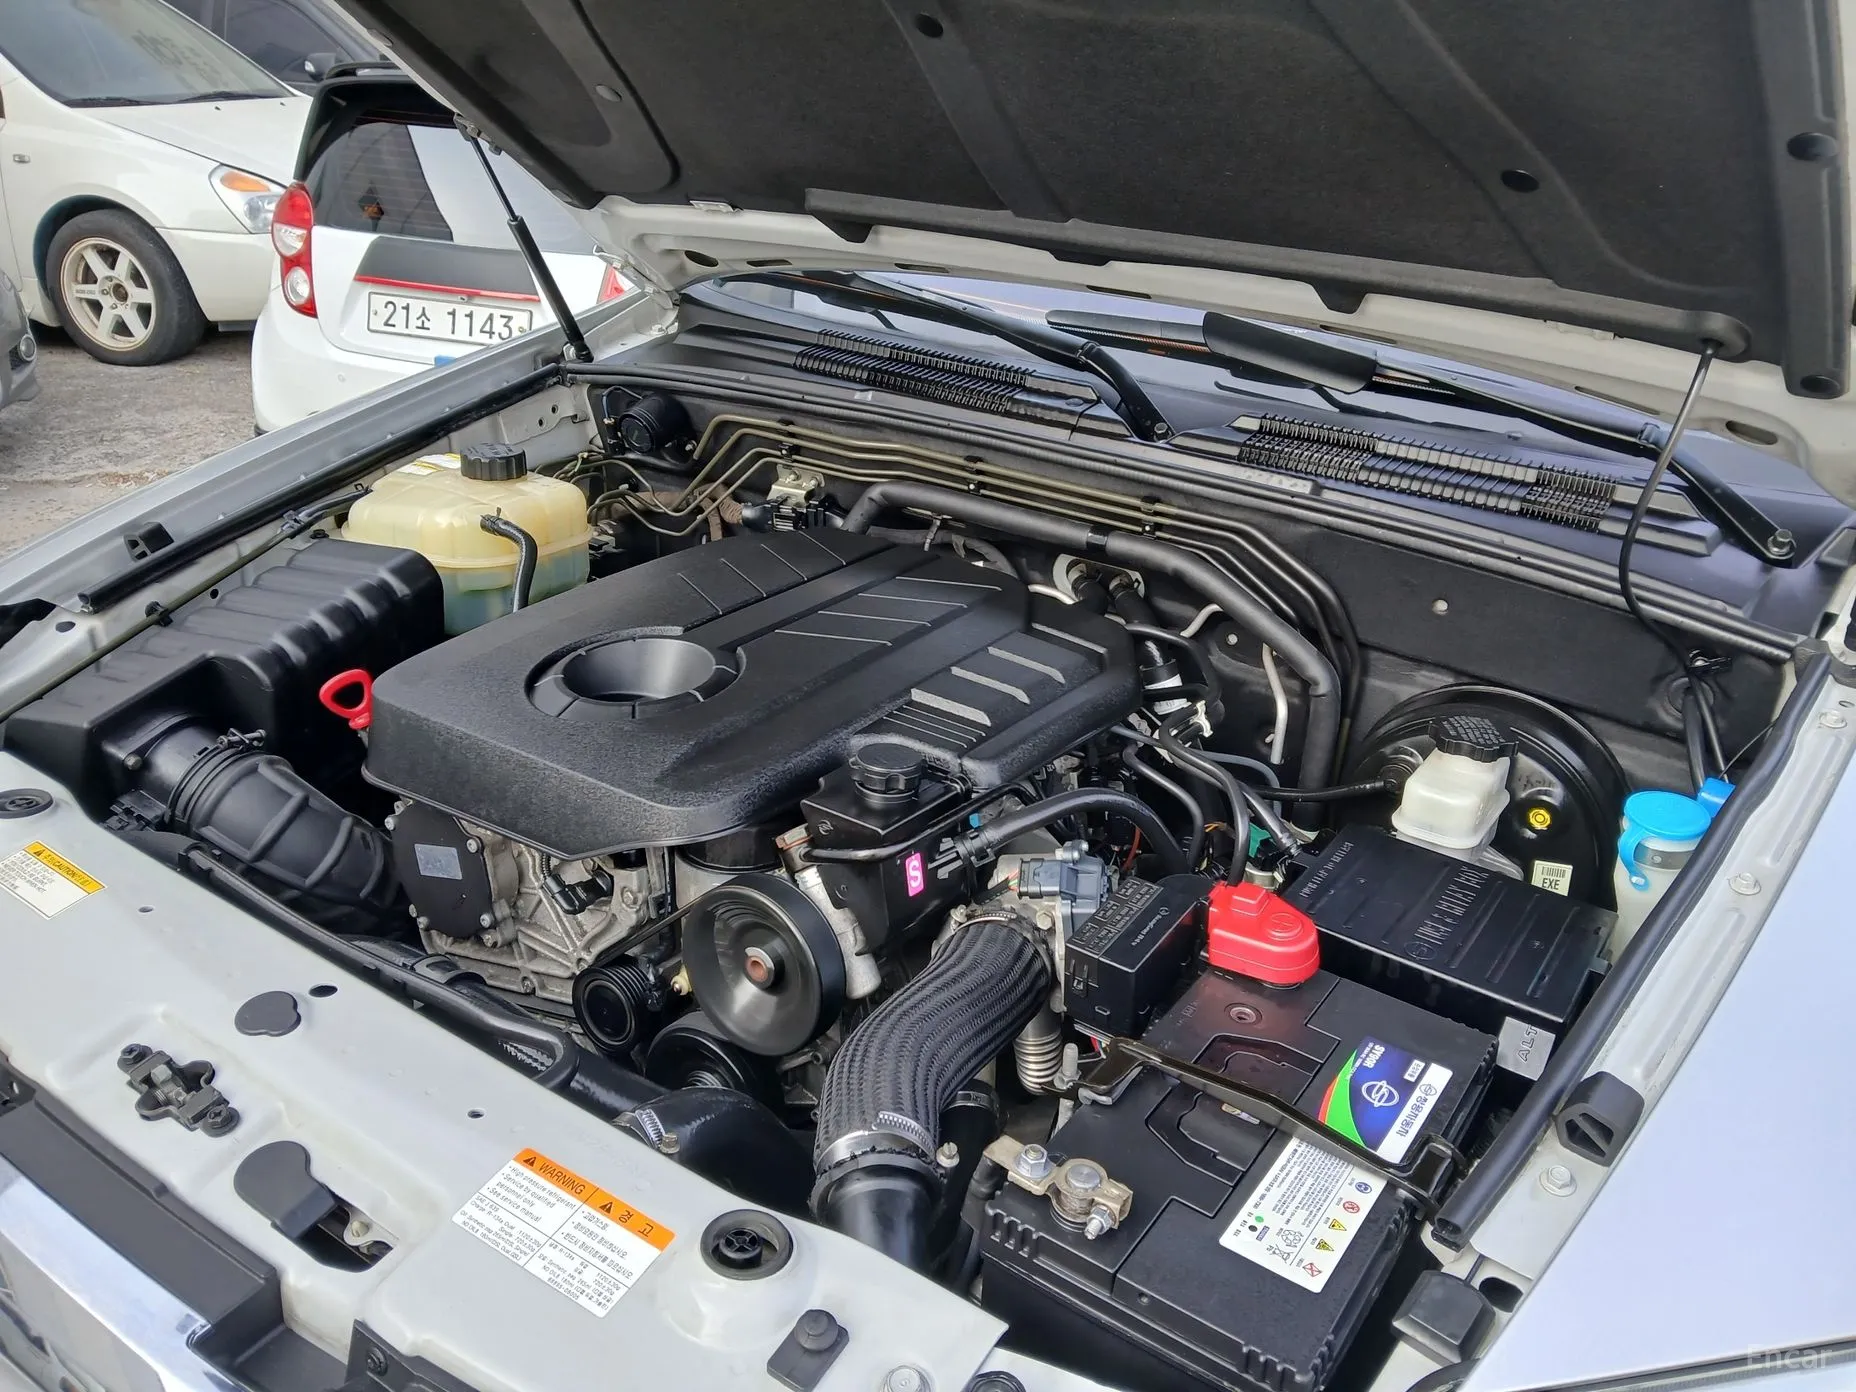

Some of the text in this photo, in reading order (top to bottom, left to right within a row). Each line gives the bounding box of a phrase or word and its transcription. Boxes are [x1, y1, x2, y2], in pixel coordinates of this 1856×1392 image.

[383, 301, 514, 341] 21소 1143
[908, 859, 921, 888] S
[1541, 877, 1561, 890] EXE
[1517, 1024, 1538, 1062] ALT
[1396, 1095, 1428, 1137] 쌍용자동차
[496, 1181, 535, 1208] personnel only
[503, 1173, 556, 1209] Service by qualified
[510, 1167, 577, 1210] High pressure refrigerant
[539, 1162, 586, 1195] WARNING
[489, 1187, 542, 1223] See service manual
[618, 1209, 654, 1238] 경 고
